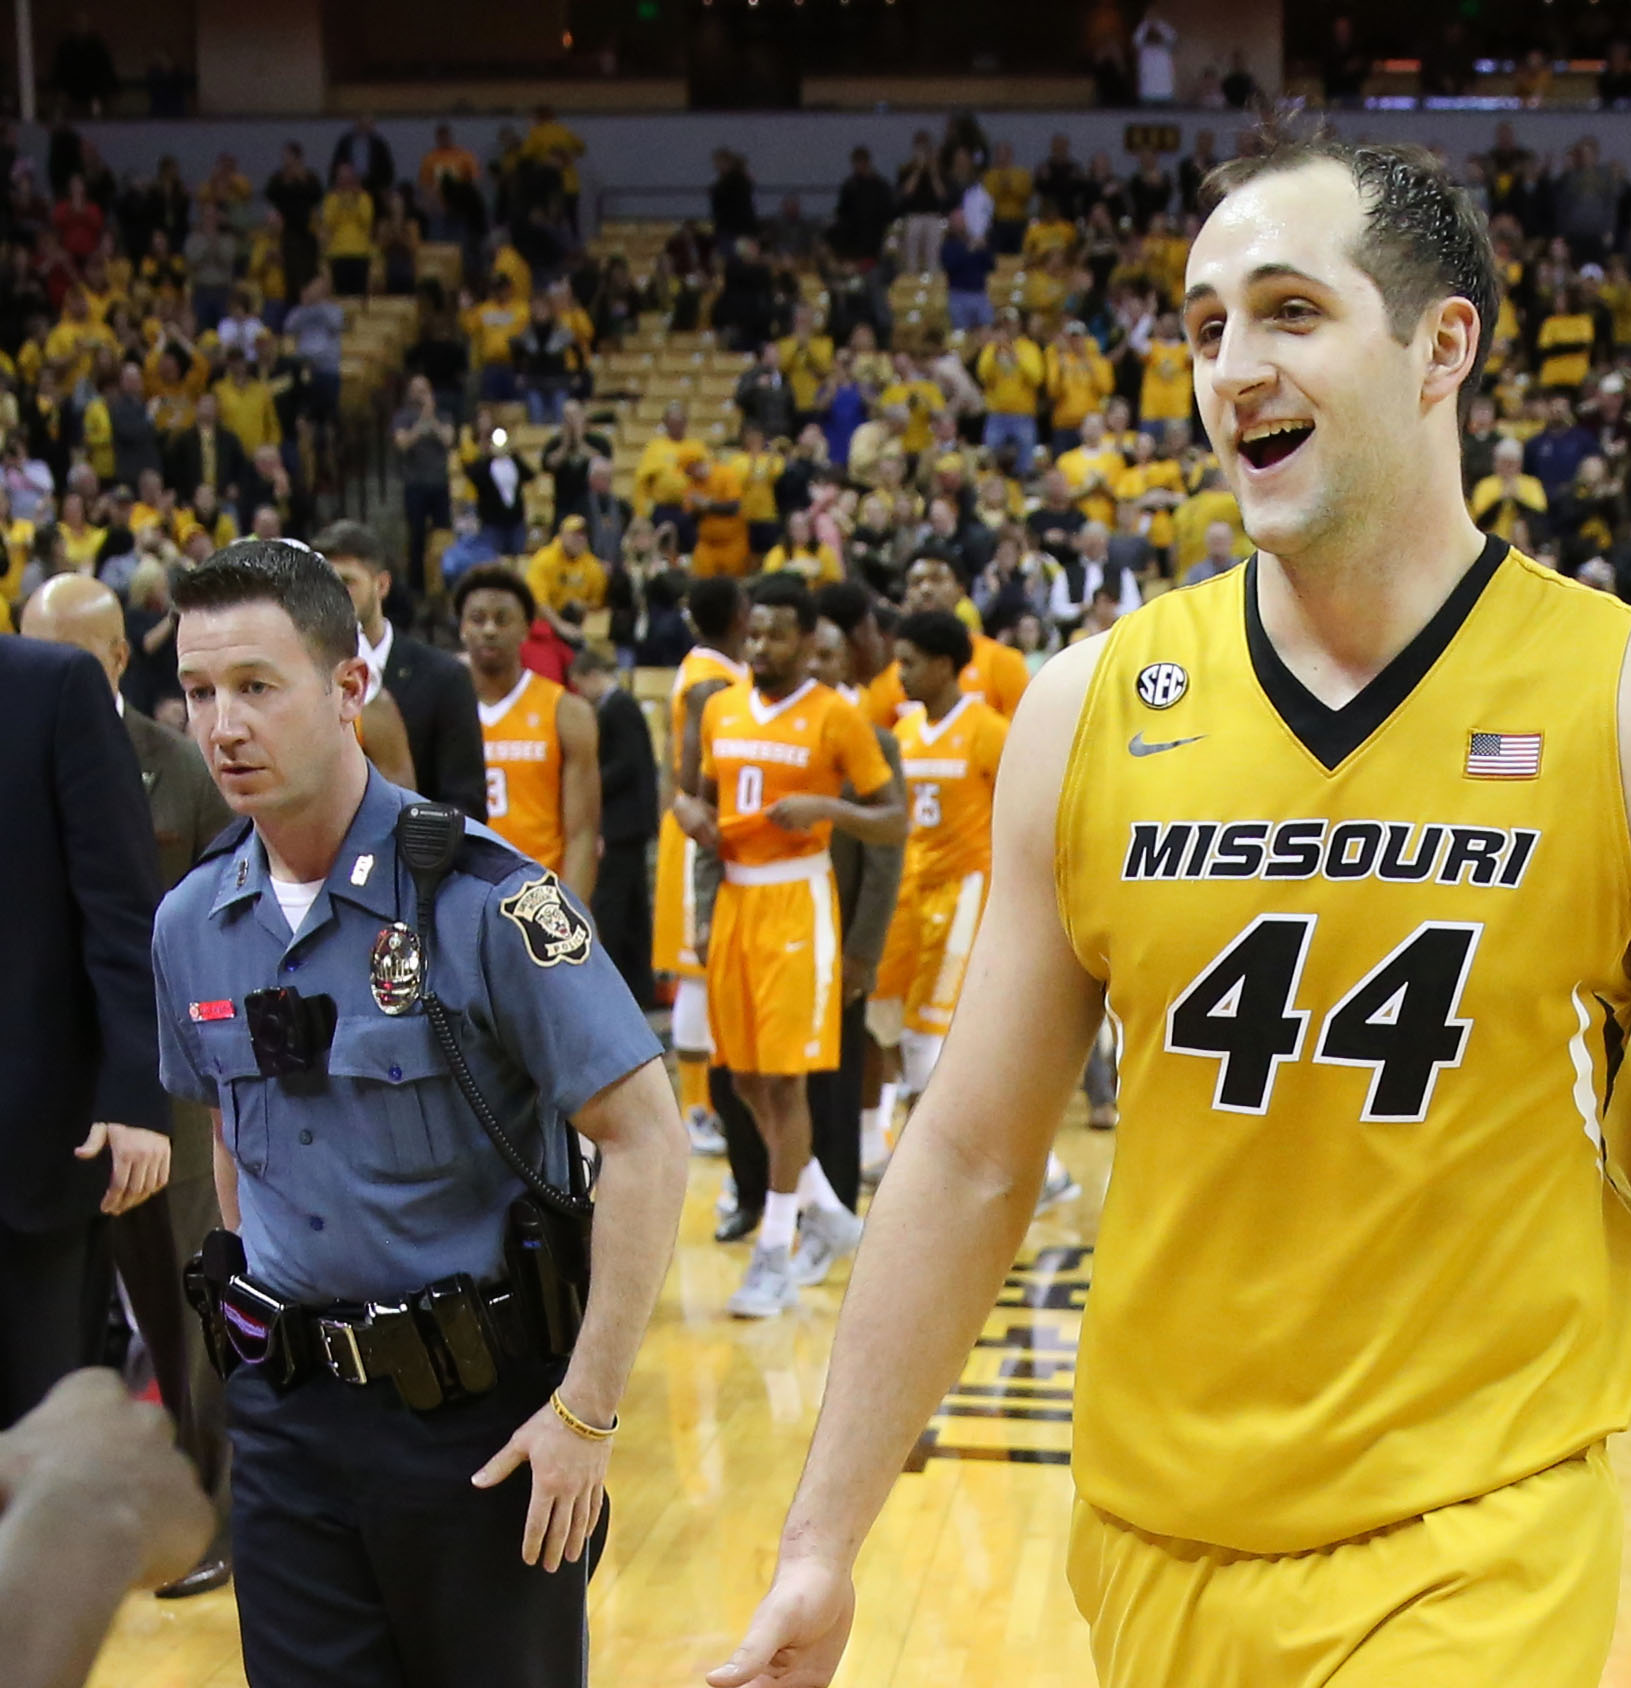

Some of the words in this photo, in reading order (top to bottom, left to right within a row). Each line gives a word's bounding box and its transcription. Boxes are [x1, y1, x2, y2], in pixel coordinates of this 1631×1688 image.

[1139, 664, 1184, 705] SEC
[736, 765, 763, 814] 0
[1121, 819, 1542, 889] MISSOURI
[1164, 912, 1485, 1123] 44
